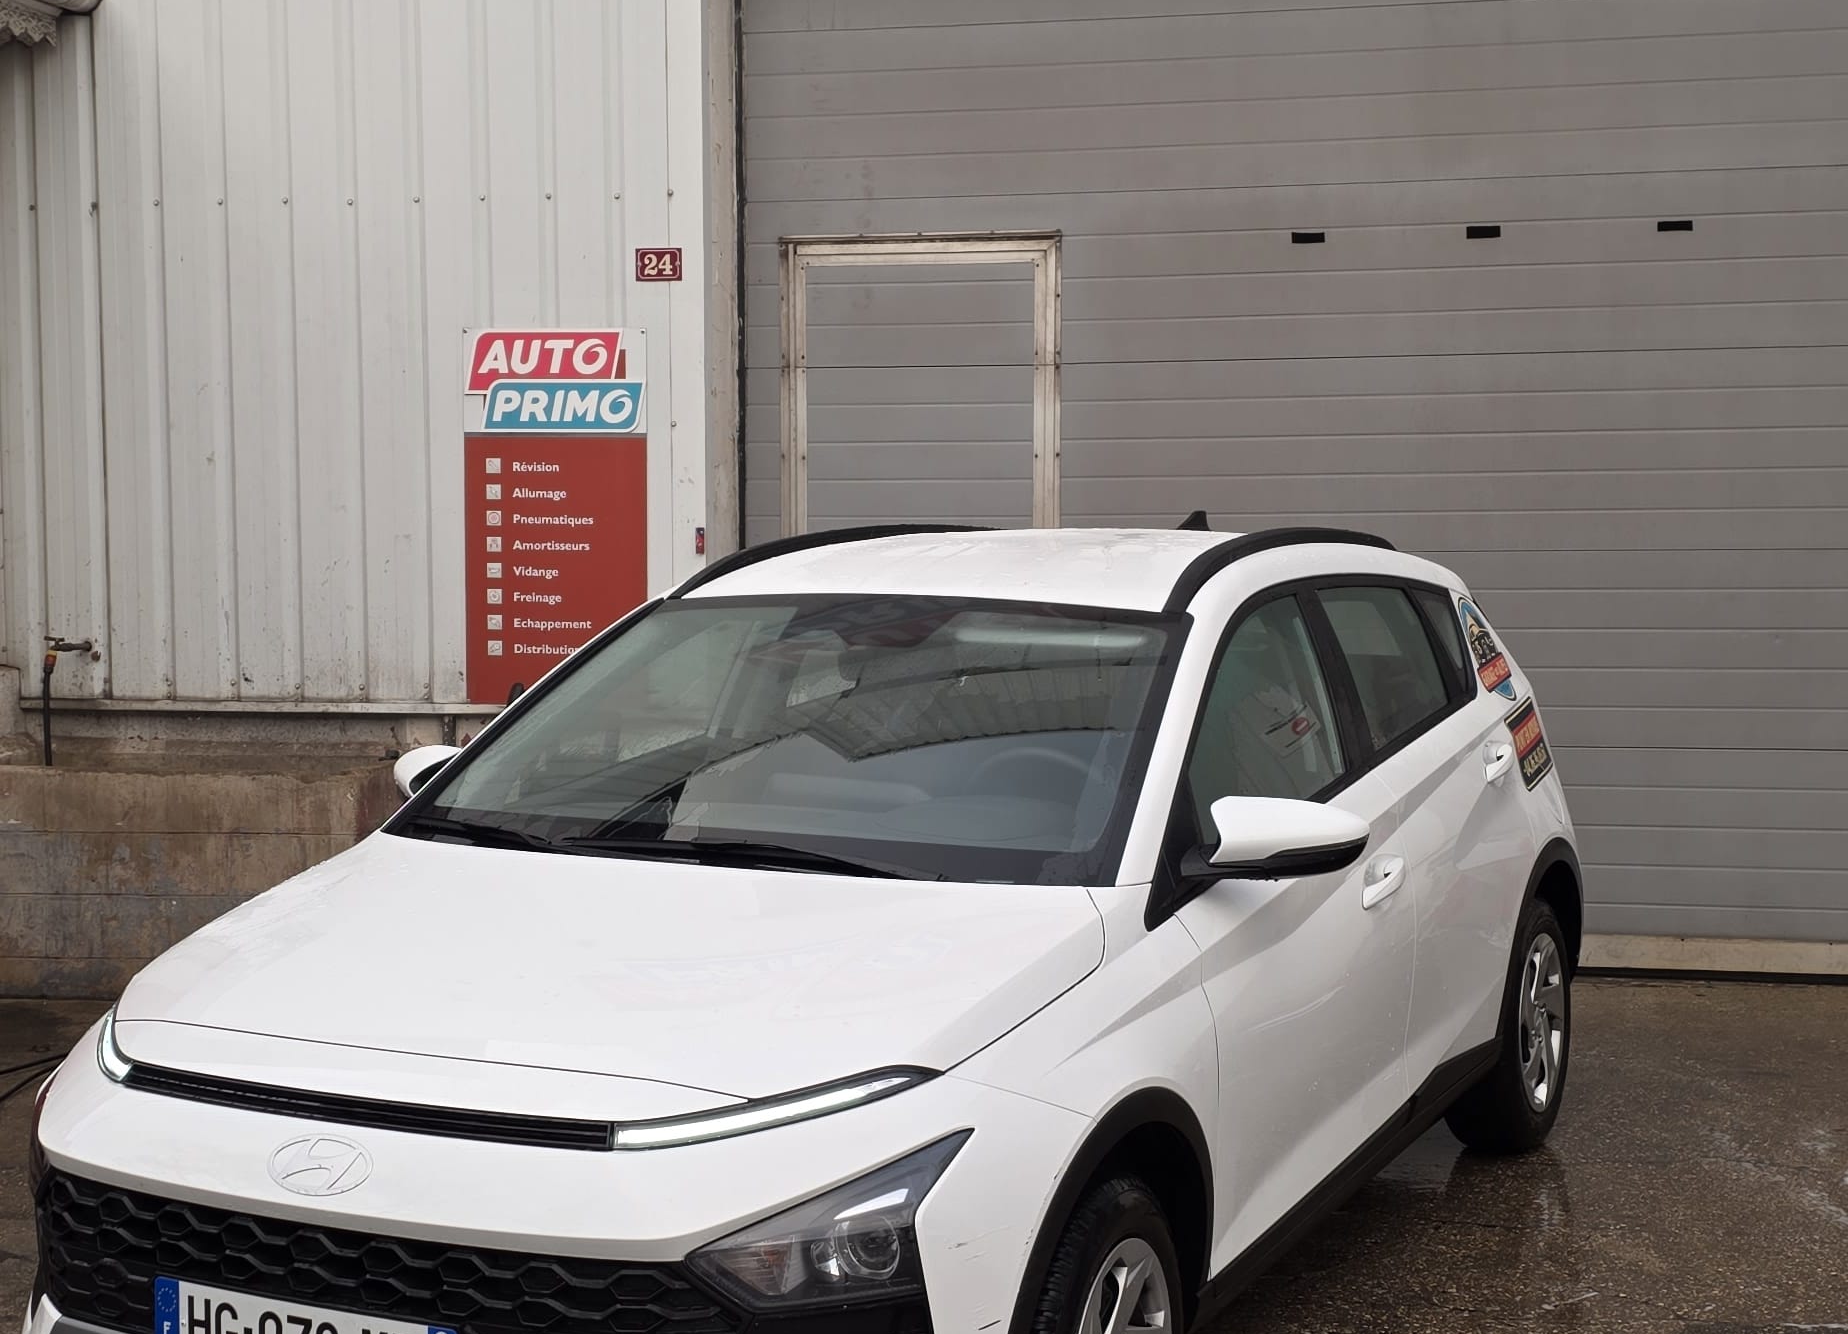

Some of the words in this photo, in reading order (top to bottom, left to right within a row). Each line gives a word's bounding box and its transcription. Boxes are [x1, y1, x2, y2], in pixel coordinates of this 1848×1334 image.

[643, 253, 673, 276] 24
[477, 338, 608, 375] AUTO
[492, 388, 633, 424] PRIMO
[512, 461, 560, 472] Révision
[512, 487, 567, 501] Allumage
[512, 514, 594, 527] Pneumatiques
[512, 539, 591, 551] Amortisseurs
[513, 566, 559, 580] Vidange
[513, 591, 563, 605] Freinage
[513, 618, 592, 631] Echappement
[514, 643, 581, 655] Distributio
